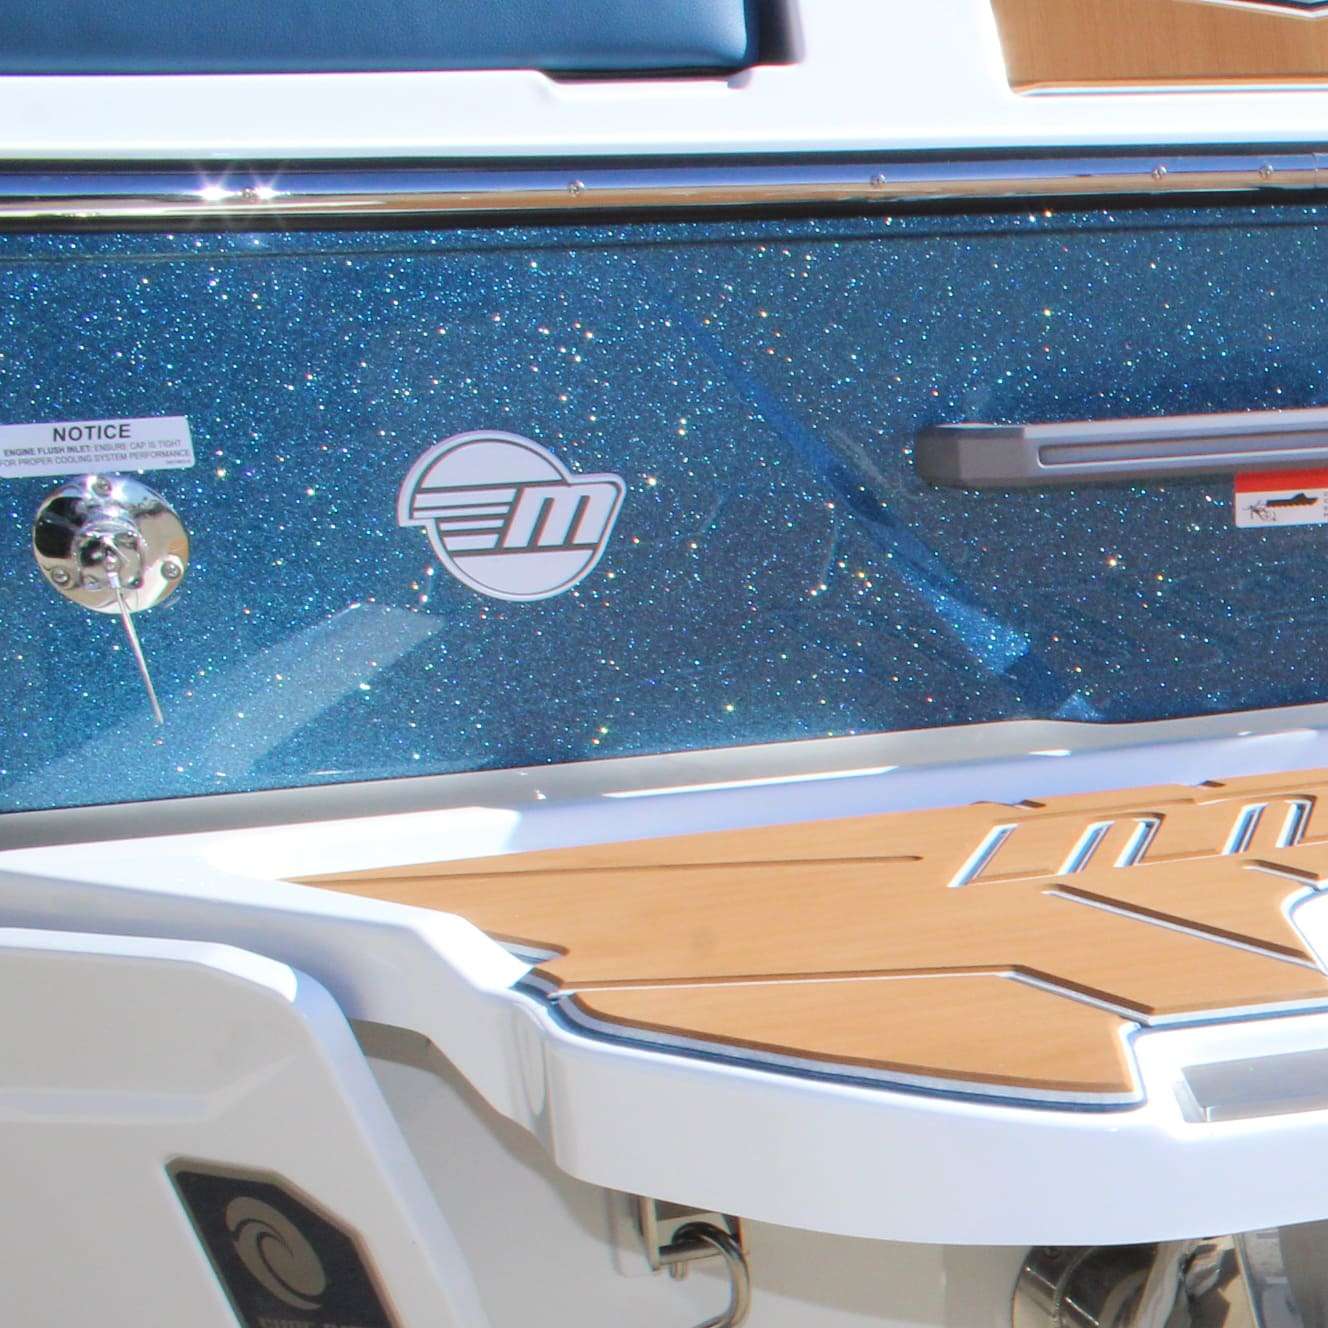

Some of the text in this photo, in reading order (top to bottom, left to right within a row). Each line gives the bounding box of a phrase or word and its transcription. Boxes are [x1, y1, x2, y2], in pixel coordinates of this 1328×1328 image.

[53, 424, 131, 442] NOTICE
[4, 448, 36, 457] ENGINE
[37, 446, 65, 455] FLUSH
[130, 441, 146, 450] CAP
[148, 440, 156, 448] IS
[158, 439, 181, 448] TIGHT
[0, 458, 17, 467] FOR
[18, 456, 53, 465] PROPER
[55, 455, 92, 464] COOLING
[94, 452, 127, 462] SYSTEM
